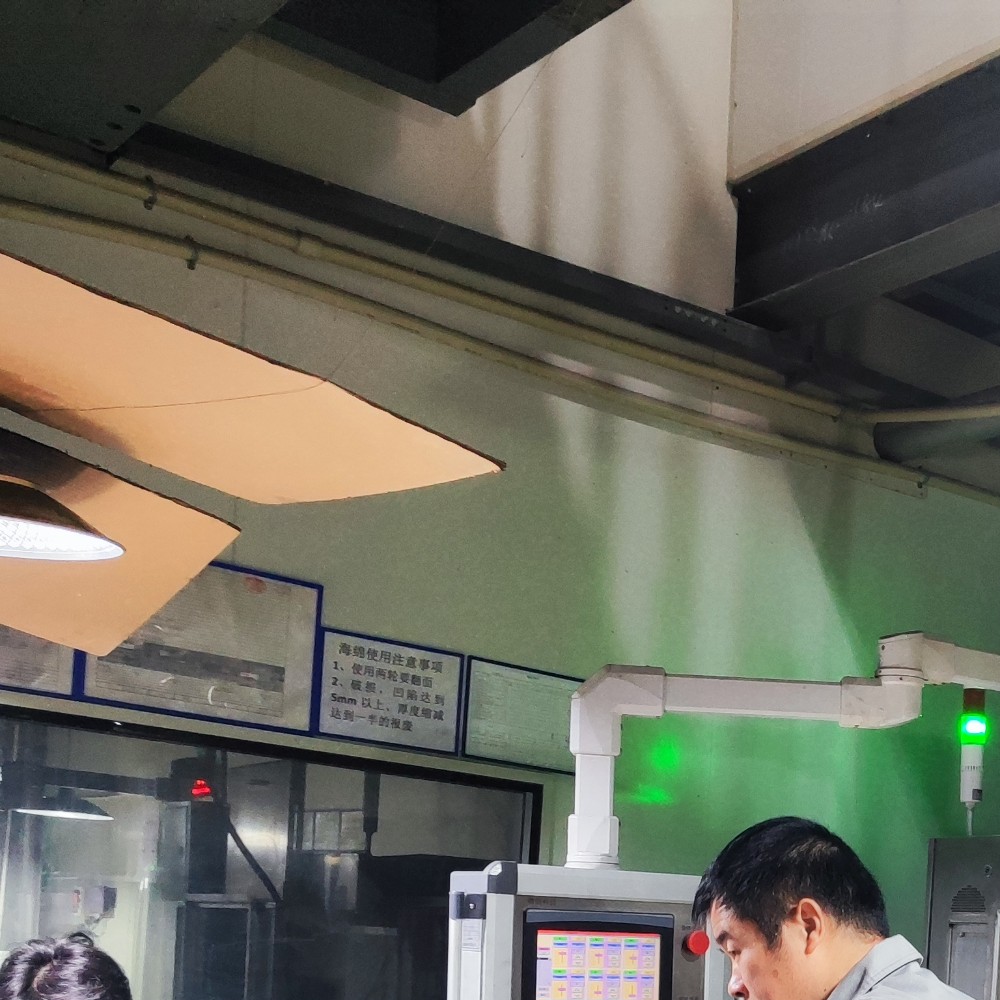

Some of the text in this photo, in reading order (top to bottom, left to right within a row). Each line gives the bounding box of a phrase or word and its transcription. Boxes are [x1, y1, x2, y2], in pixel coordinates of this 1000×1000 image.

[338, 642, 444, 674] 海绵使用注意事项
[330, 693, 357, 706] 5mm
